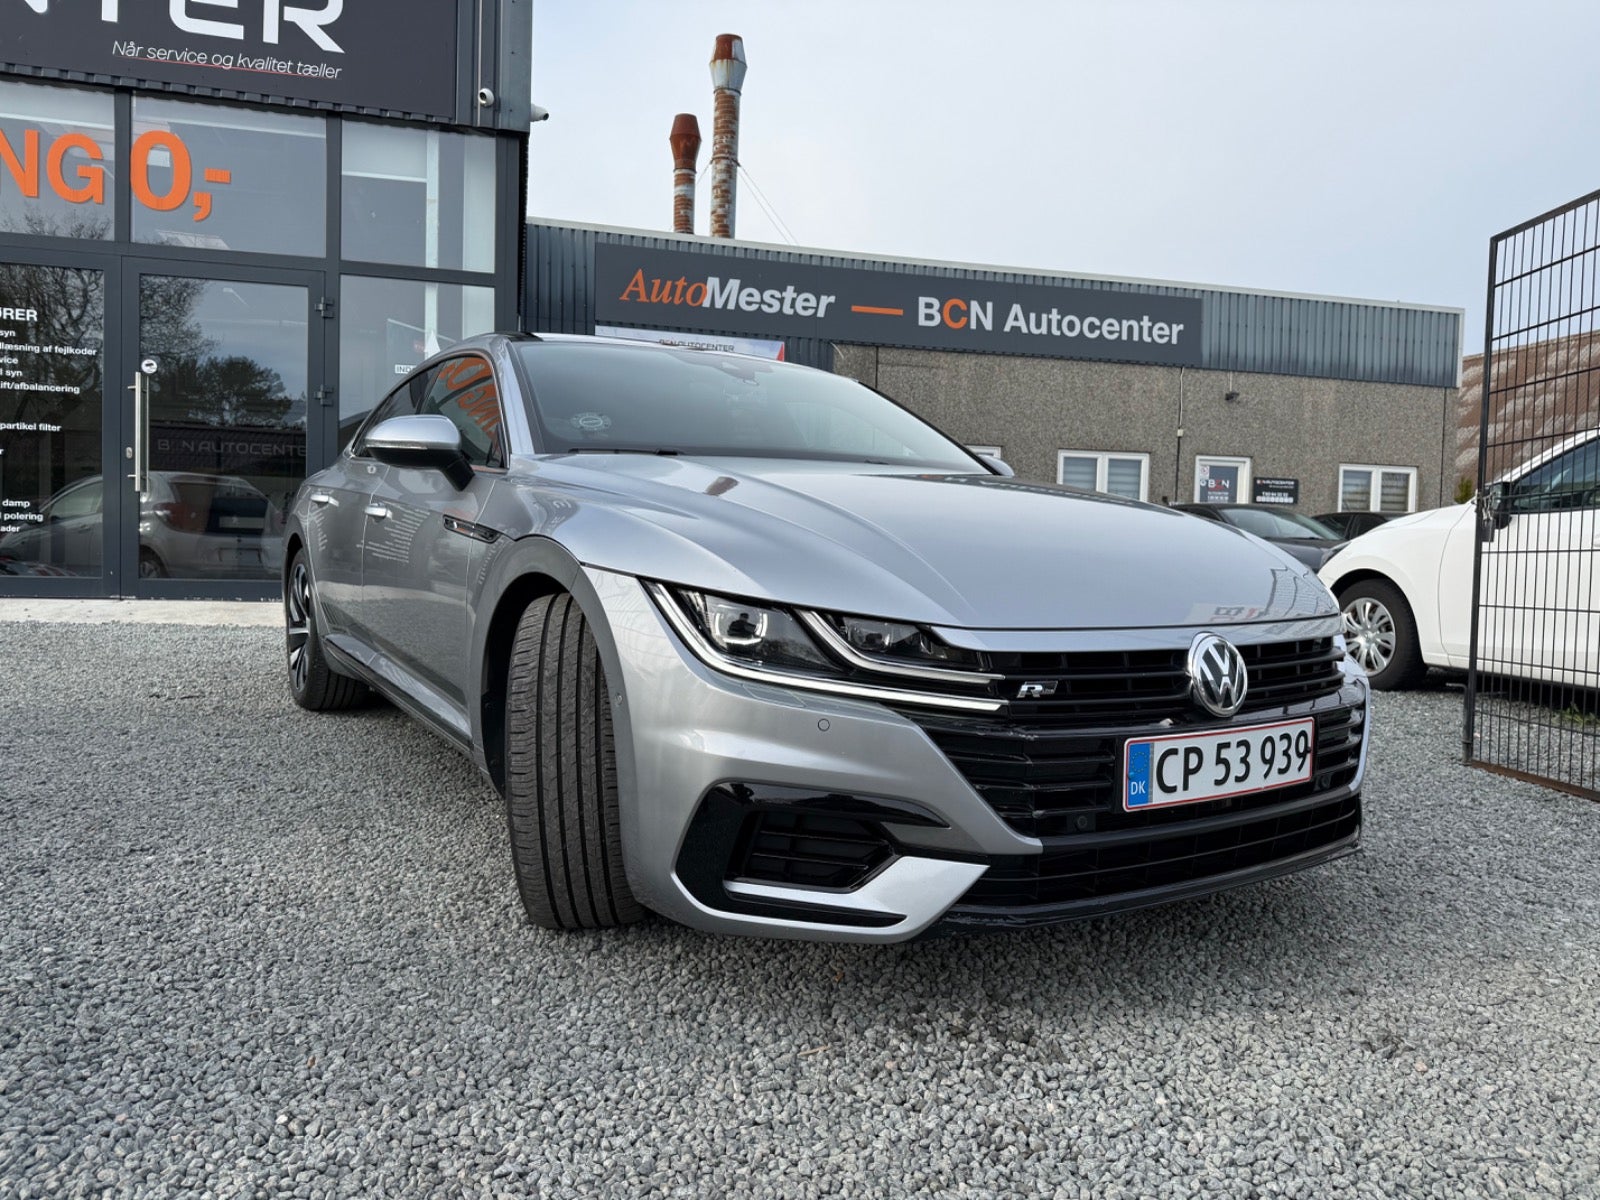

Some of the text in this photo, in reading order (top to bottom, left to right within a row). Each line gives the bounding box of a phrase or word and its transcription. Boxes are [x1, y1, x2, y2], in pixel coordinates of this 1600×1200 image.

[112, 40, 343, 79] Når service og kvalitet tæller
[0, 306, 38, 322] RER
[918, 296, 1184, 345] BCN Autocenter
[43, 345, 53, 353] af
[54, 346, 97, 356] fejlkoder
[5, 369, 23, 378] syn
[0, 422, 62, 432] partikel filter
[2, 498, 31, 508] damp
[4, 512, 44, 522] polering
[1156, 729, 1310, 794] CP 53 939
[1130, 780, 1146, 796] DK
